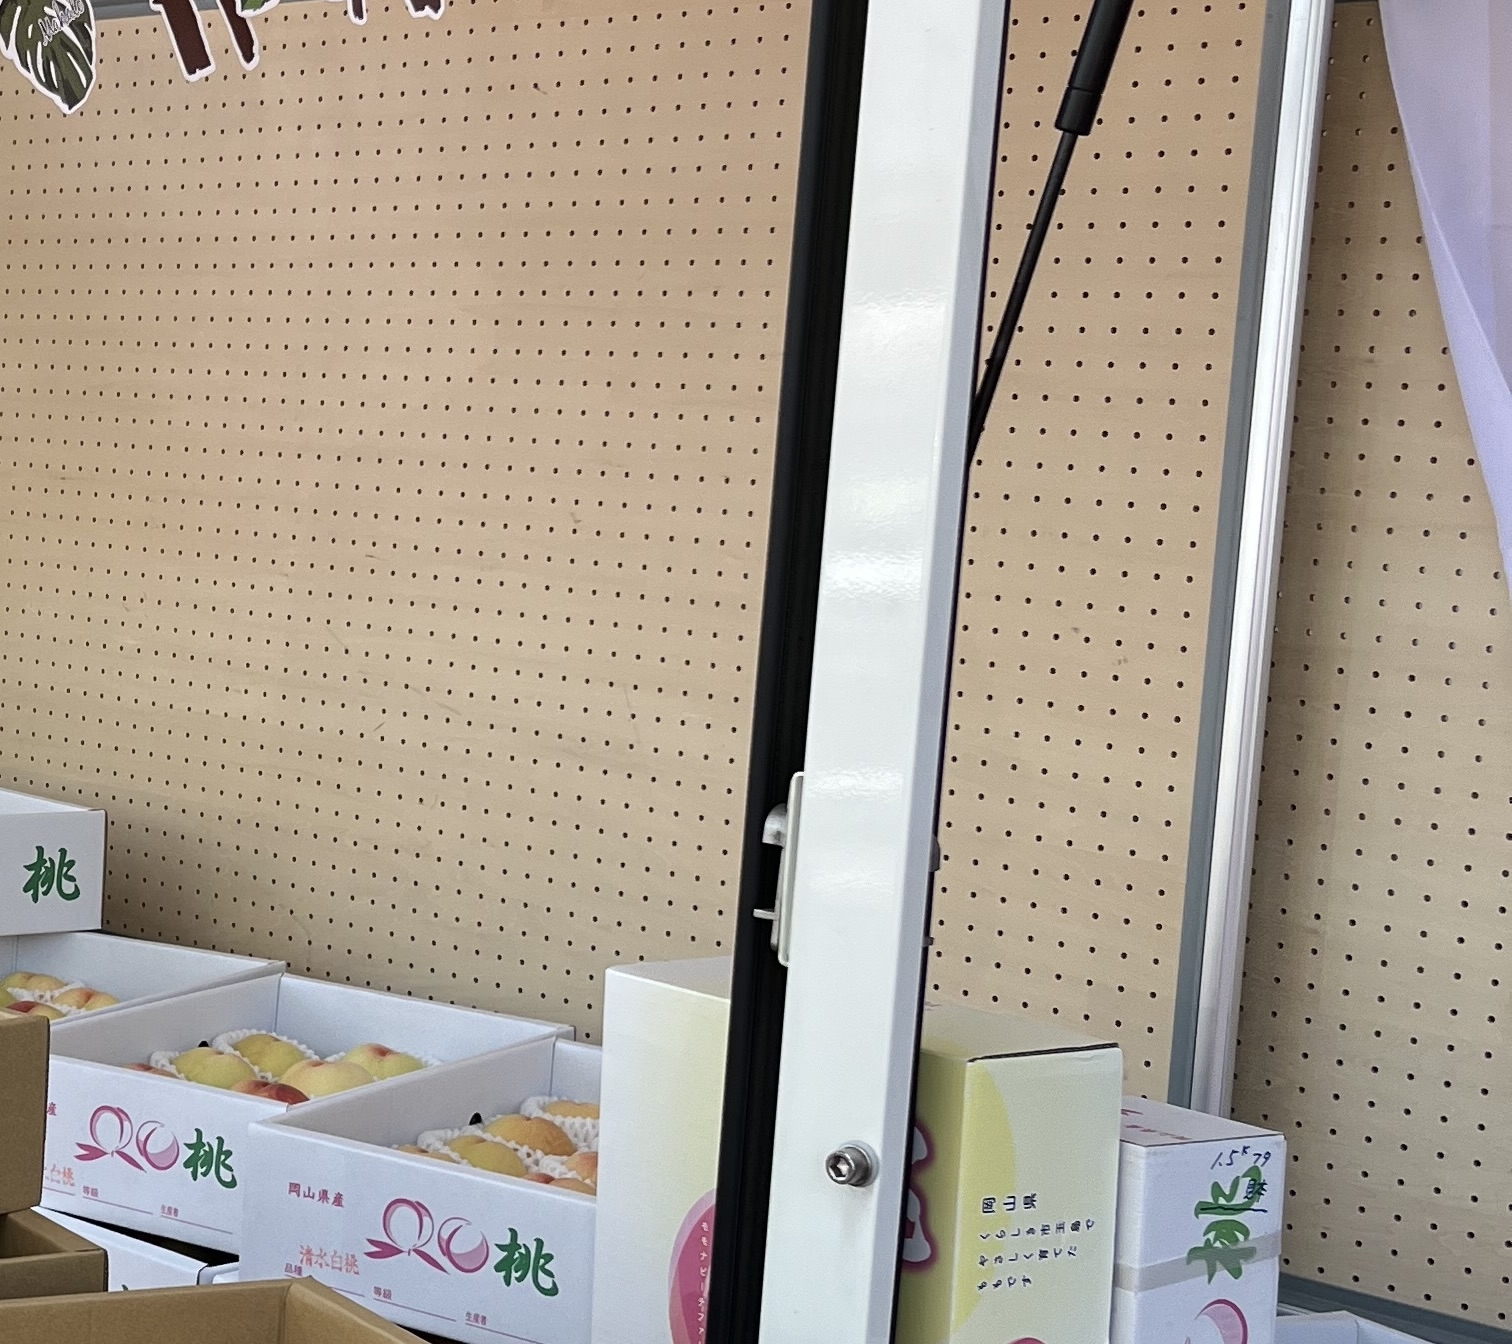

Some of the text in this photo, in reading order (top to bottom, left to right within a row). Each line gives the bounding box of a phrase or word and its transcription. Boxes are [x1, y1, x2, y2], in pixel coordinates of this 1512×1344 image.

[23, 845, 81, 904] 桃
[183, 1127, 237, 1189] 桃
[289, 1181, 345, 1208] 岡山県産
[981, 1192, 1038, 1214] 岡山県
[494, 1227, 559, 1297] 桃
[976, 1275, 1033, 1292] ももです
